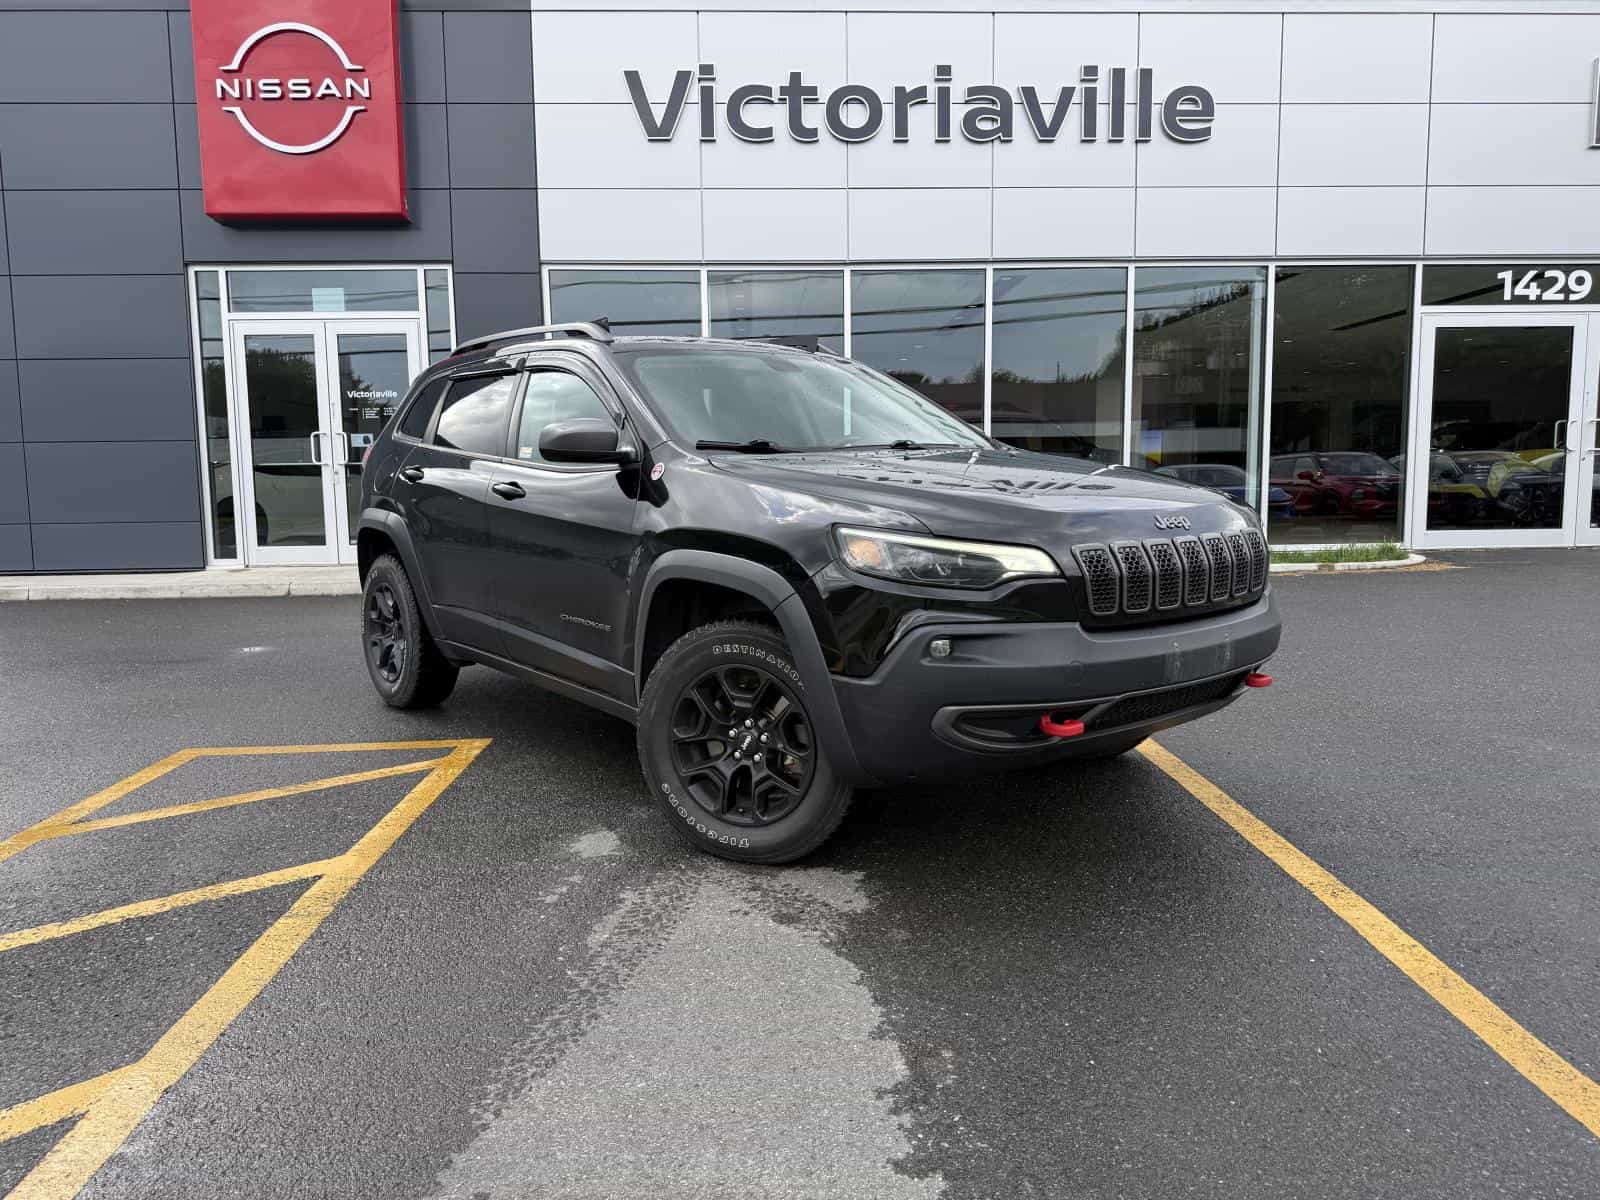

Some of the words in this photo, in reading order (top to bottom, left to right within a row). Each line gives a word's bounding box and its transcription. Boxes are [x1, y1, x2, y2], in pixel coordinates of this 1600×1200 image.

[215, 77, 371, 99] NISSAN
[623, 64, 1216, 143] Victoriaville
[1496, 269, 1593, 301] 1429
[347, 389, 398, 399] Victoriaville
[1153, 514, 1192, 531] Jeep
